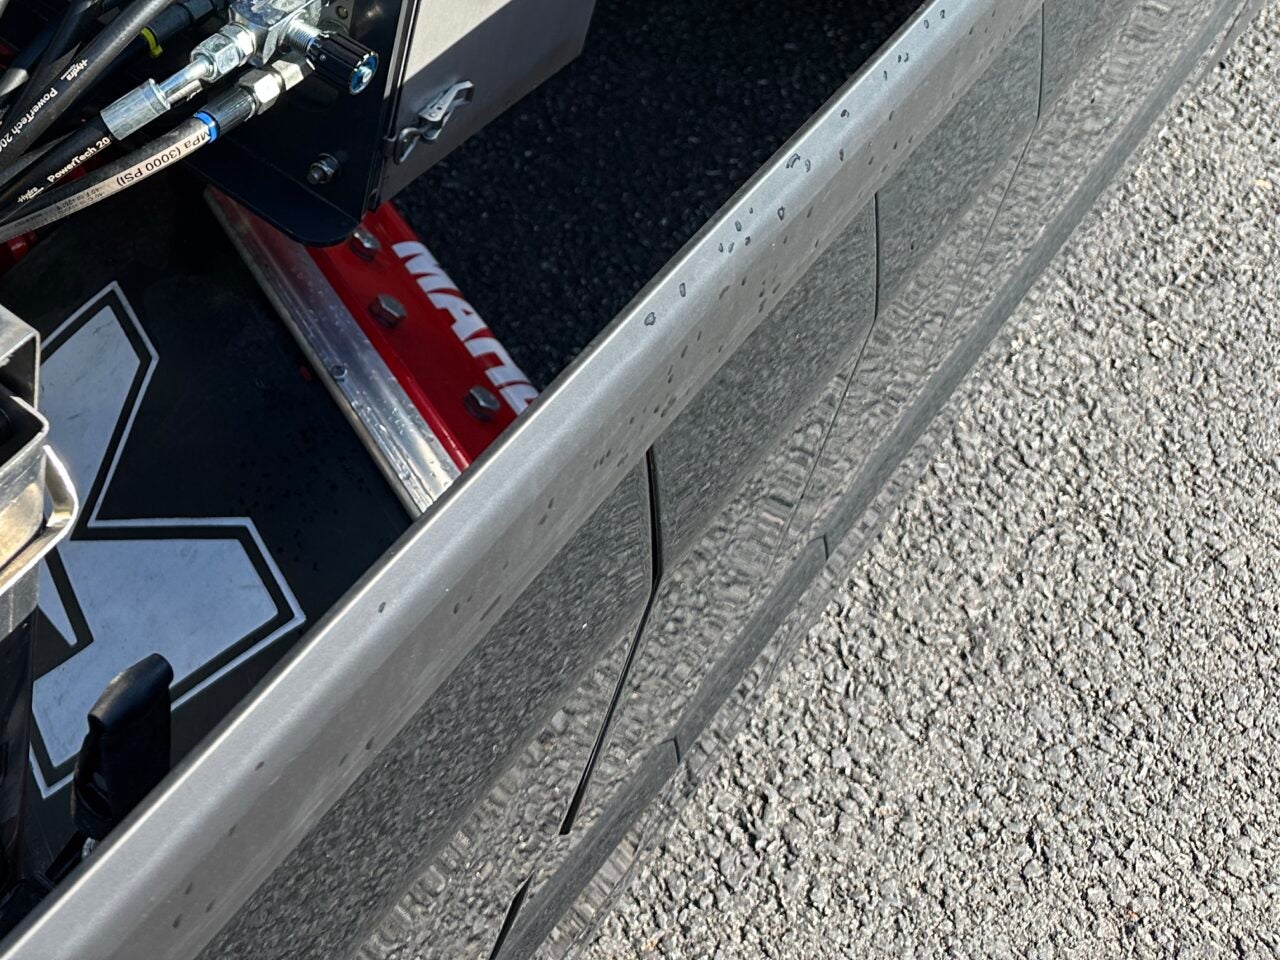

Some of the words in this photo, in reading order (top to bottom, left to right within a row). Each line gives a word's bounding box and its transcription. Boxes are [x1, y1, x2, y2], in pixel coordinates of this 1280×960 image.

[11, 87, 58, 135] PowerTech
[47, 146, 97, 183] PowerTech
[96, 136, 112, 148] 20
[116, 166, 144, 187] PSI)
[146, 146, 181, 172] (3000
